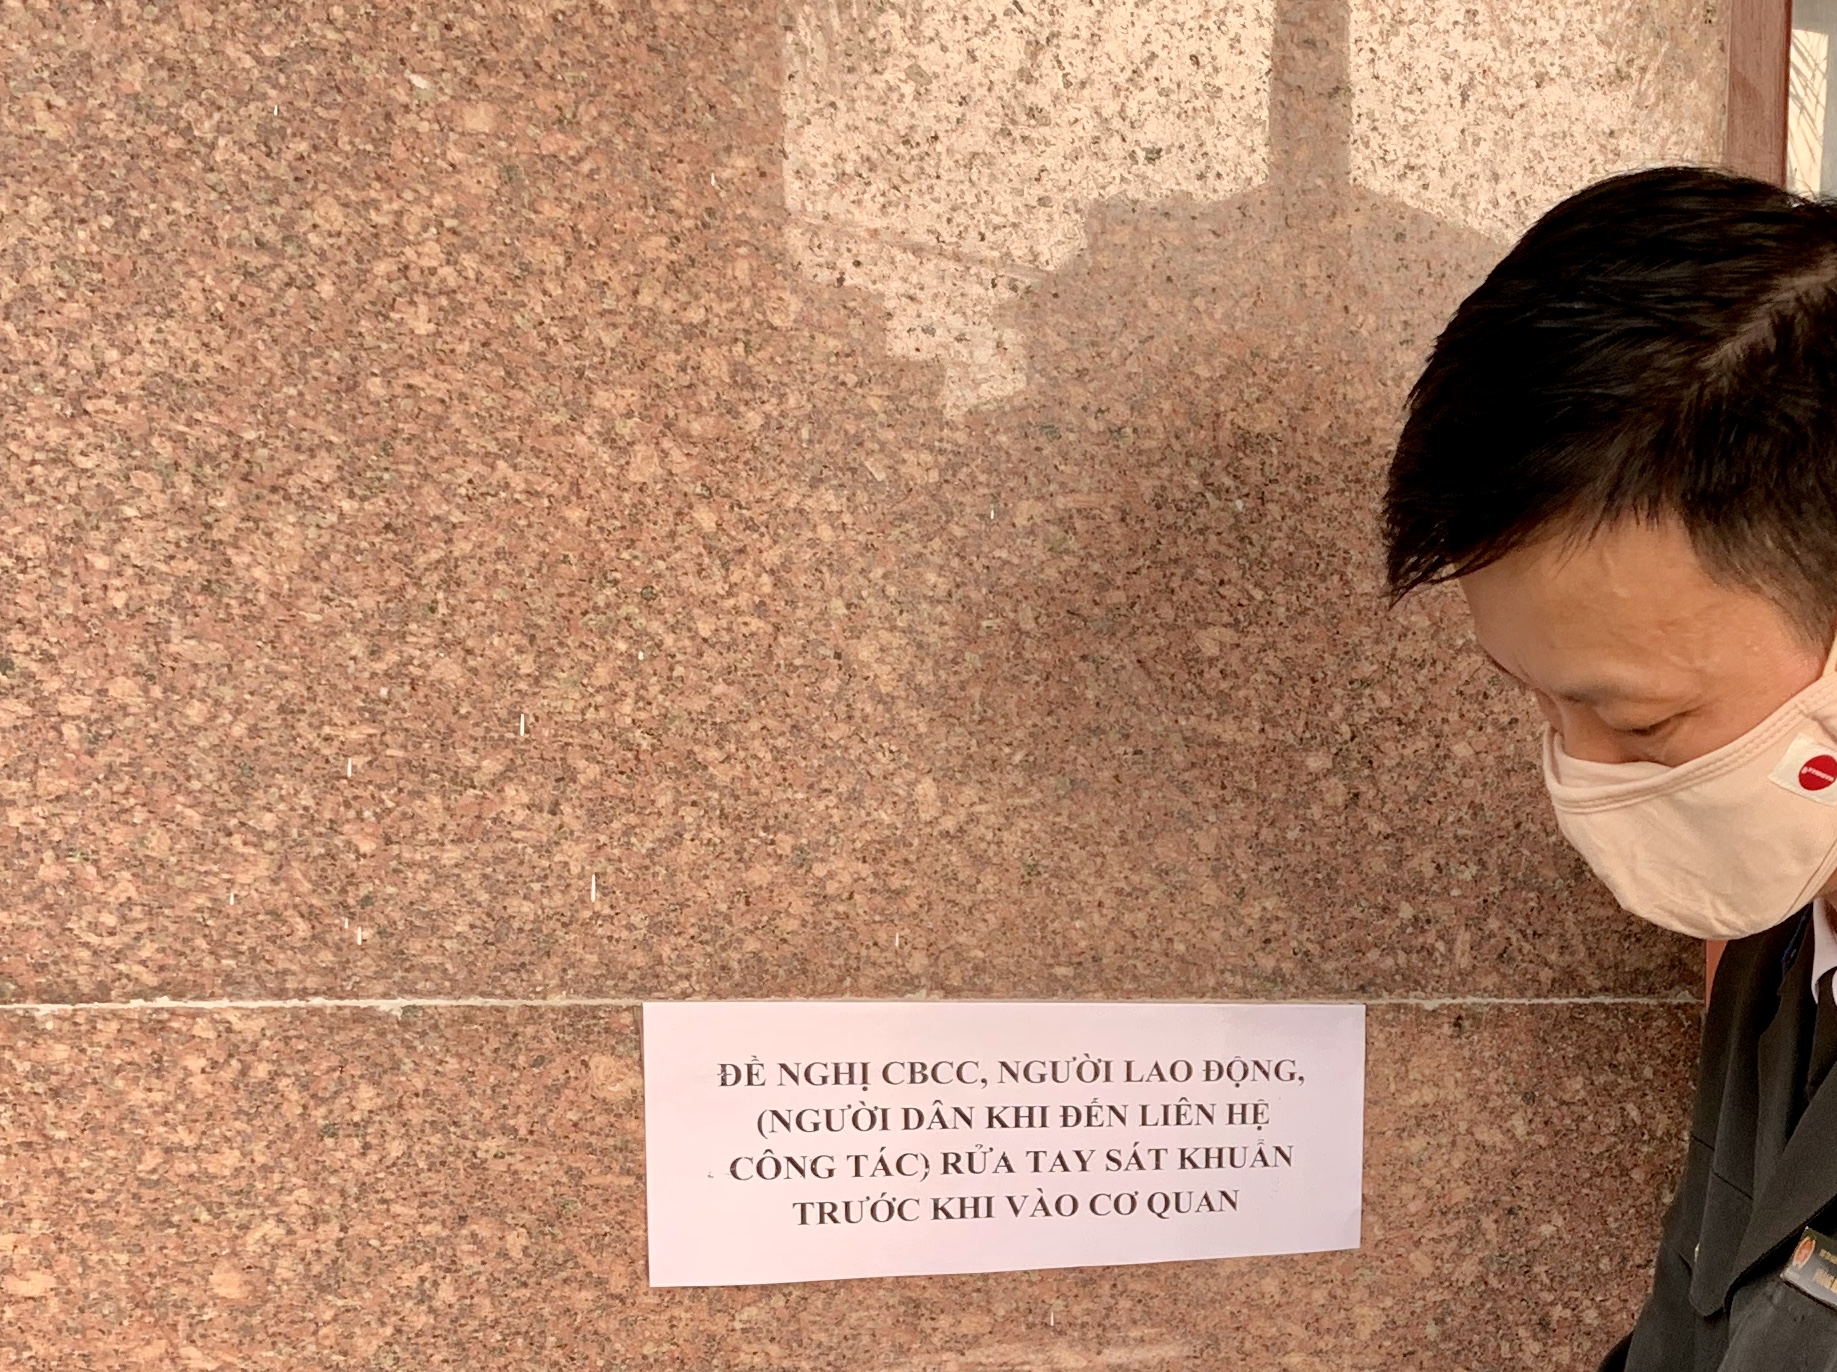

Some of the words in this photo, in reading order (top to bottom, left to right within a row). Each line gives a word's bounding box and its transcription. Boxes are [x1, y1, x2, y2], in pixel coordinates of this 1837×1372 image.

[717, 1055, 767, 1087] ĐỀ
[777, 1061, 871, 1092] NGHỊ
[882, 1060, 988, 1089] CBCC,
[997, 1053, 1112, 1084] NGƯỜI
[1123, 1059, 1194, 1083] LAO
[1202, 1055, 1305, 1088] ĐỘNG,
[757, 1100, 891, 1140] (NGƯỜI
[901, 1099, 975, 1131] DÂN
[985, 1104, 1050, 1129] KHI
[1059, 1097, 1129, 1128] ĐẾN
[1139, 1096, 1217, 1127] LIÊN
[1225, 1098, 1270, 1131] HỆ
[729, 1148, 836, 1181] CÔNG
[846, 1146, 930, 1182] TÁC)
[940, 1143, 1016, 1176] RỬA
[1026, 1149, 1096, 1173] TAY
[1105, 1141, 1168, 1172] SÁT
[792, 1192, 920, 1225] TRƯỚC
[930, 1195, 996, 1220] KHI
[1005, 1188, 1079, 1218] VÀO
[1089, 1190, 1139, 1217] CƠ
[1147, 1189, 1240, 1219] QUAN
